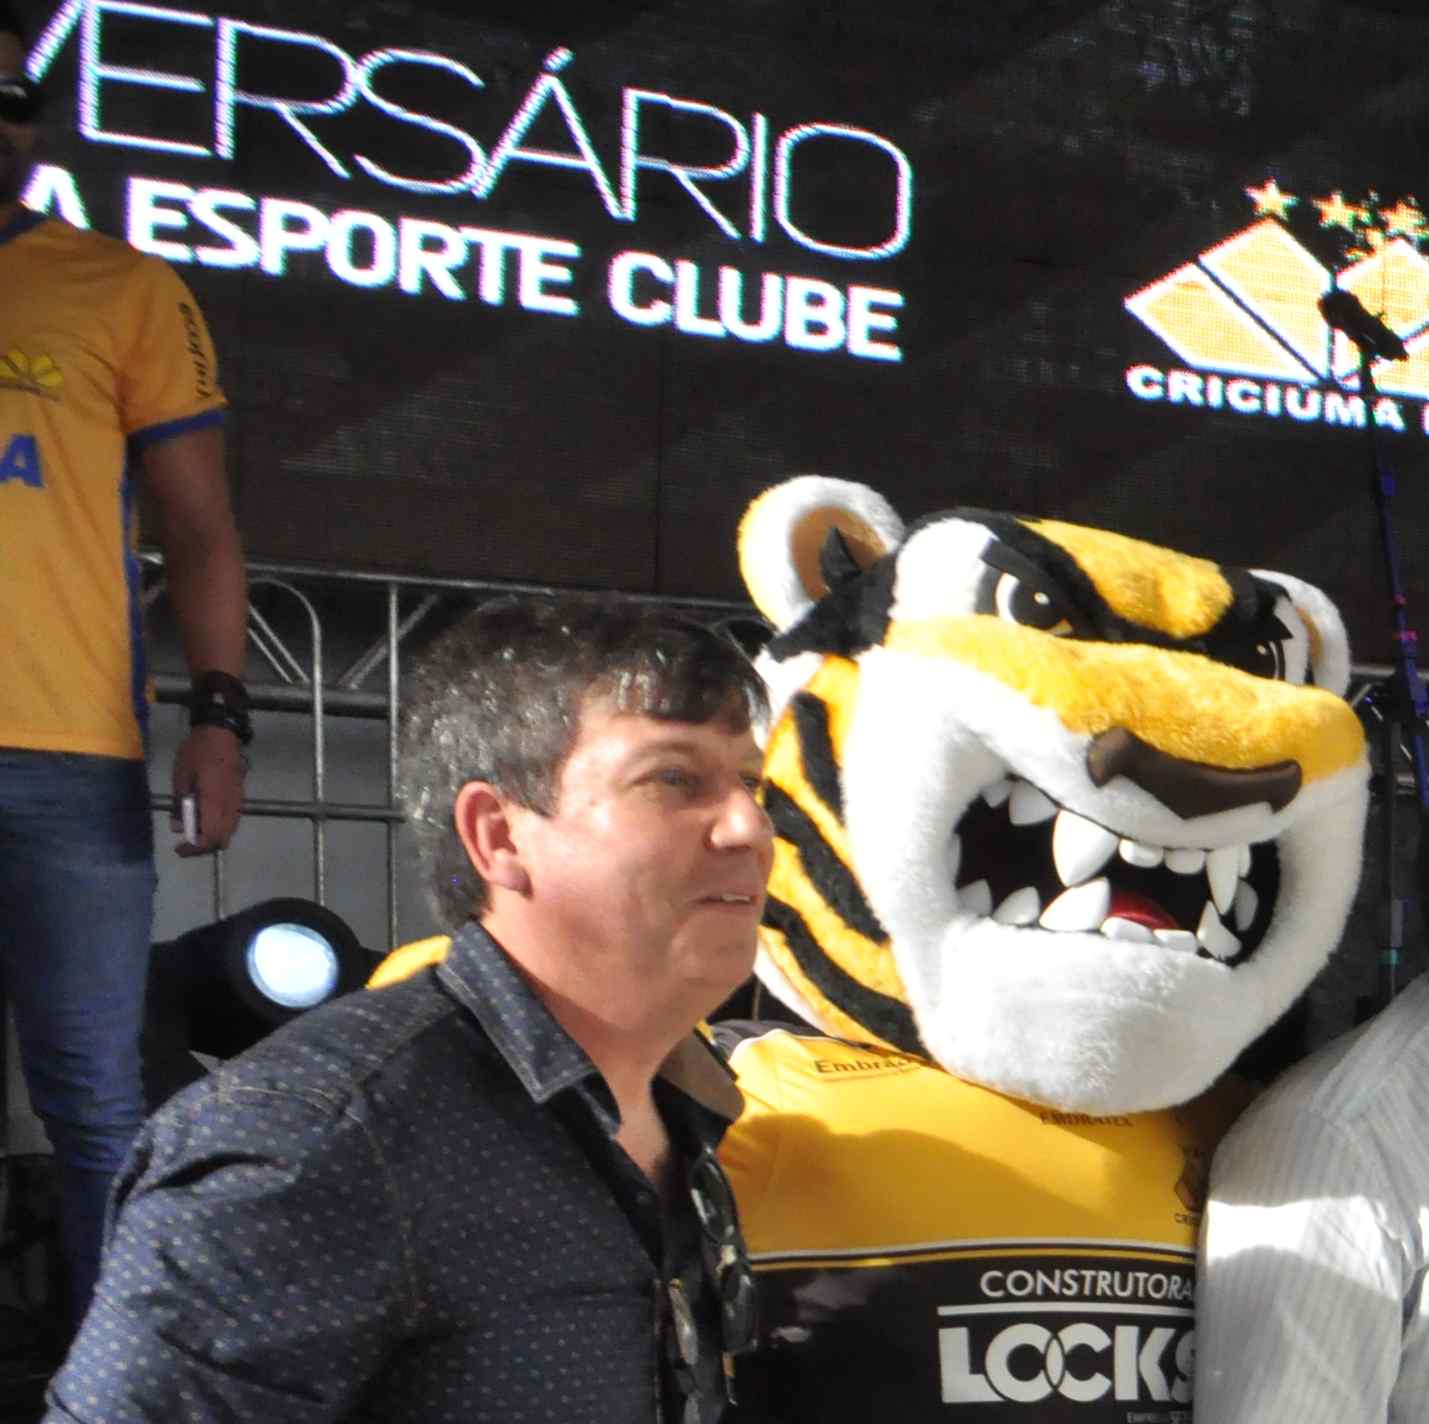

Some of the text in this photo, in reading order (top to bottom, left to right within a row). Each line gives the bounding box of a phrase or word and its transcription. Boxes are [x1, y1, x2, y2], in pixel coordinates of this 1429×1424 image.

[125, 175, 582, 317] ESPORTE
[606, 250, 906, 363] CLUBE
[979, 1268, 1193, 1300] CONSTRUTORA
